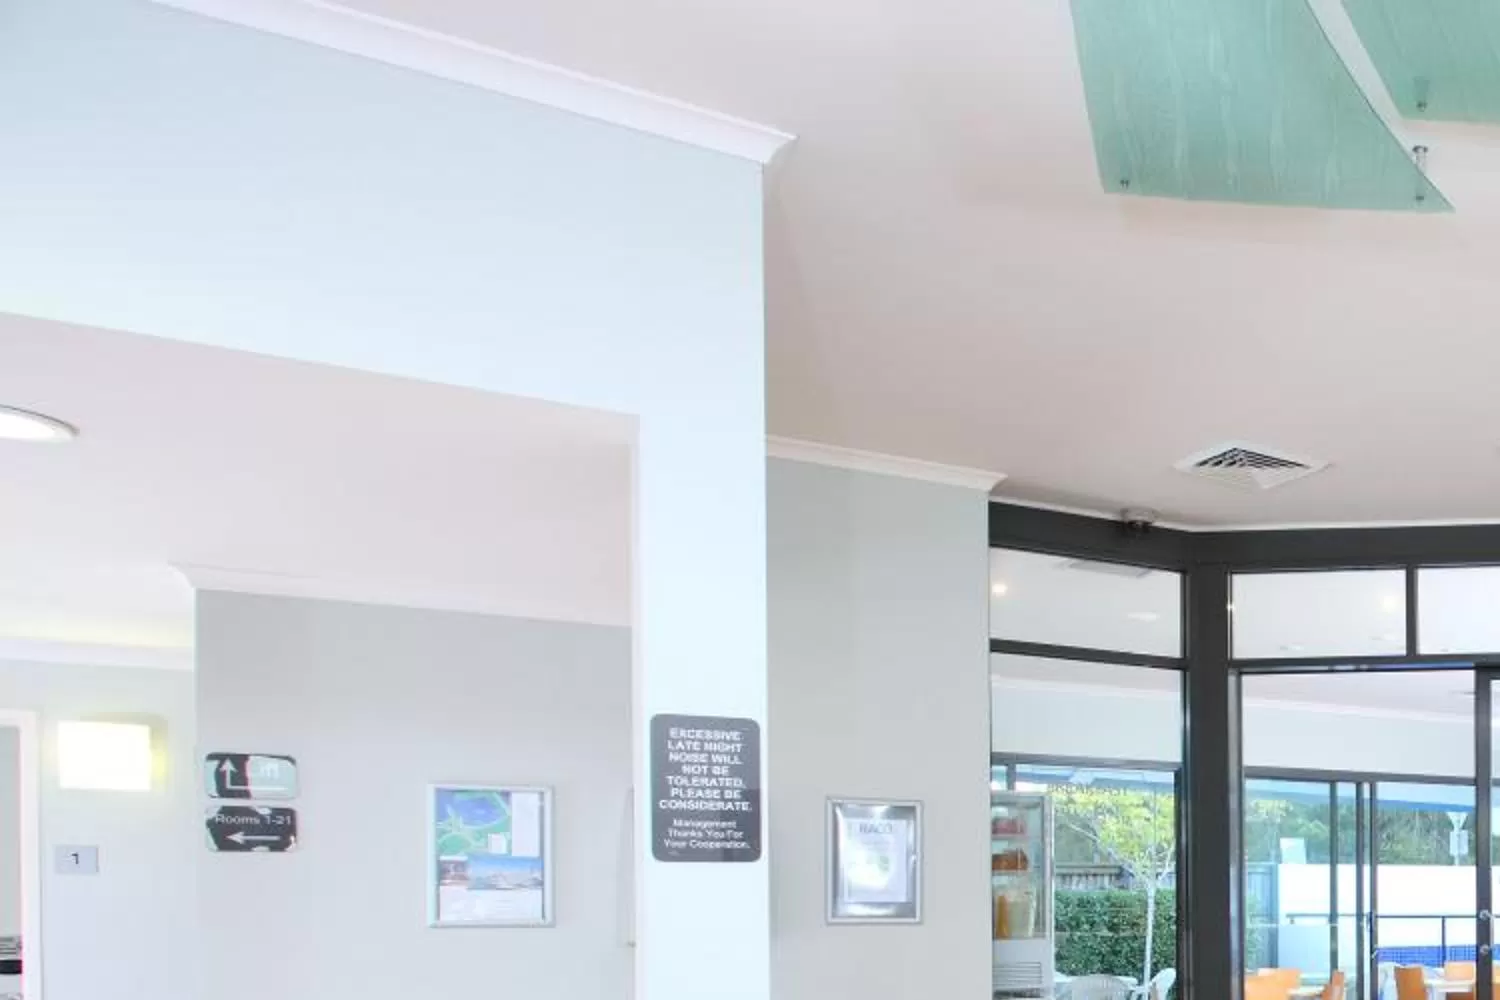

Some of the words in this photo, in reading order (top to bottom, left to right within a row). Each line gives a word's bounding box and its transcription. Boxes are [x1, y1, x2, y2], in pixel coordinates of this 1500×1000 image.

[669, 728, 743, 741] EXCESSIVE
[667, 740, 701, 750] LATE
[703, 741, 742, 752] NIGHT
[669, 752, 709, 763] NOISE
[711, 754, 743, 765] WILL
[681, 765, 709, 775] NOT
[711, 766, 730, 776] BE
[671, 788, 721, 799] PLEASE
[723, 790, 742, 799] BE
[215, 814, 261, 825] Rooms
[705, 829, 725, 838] You
[727, 829, 744, 839] For
